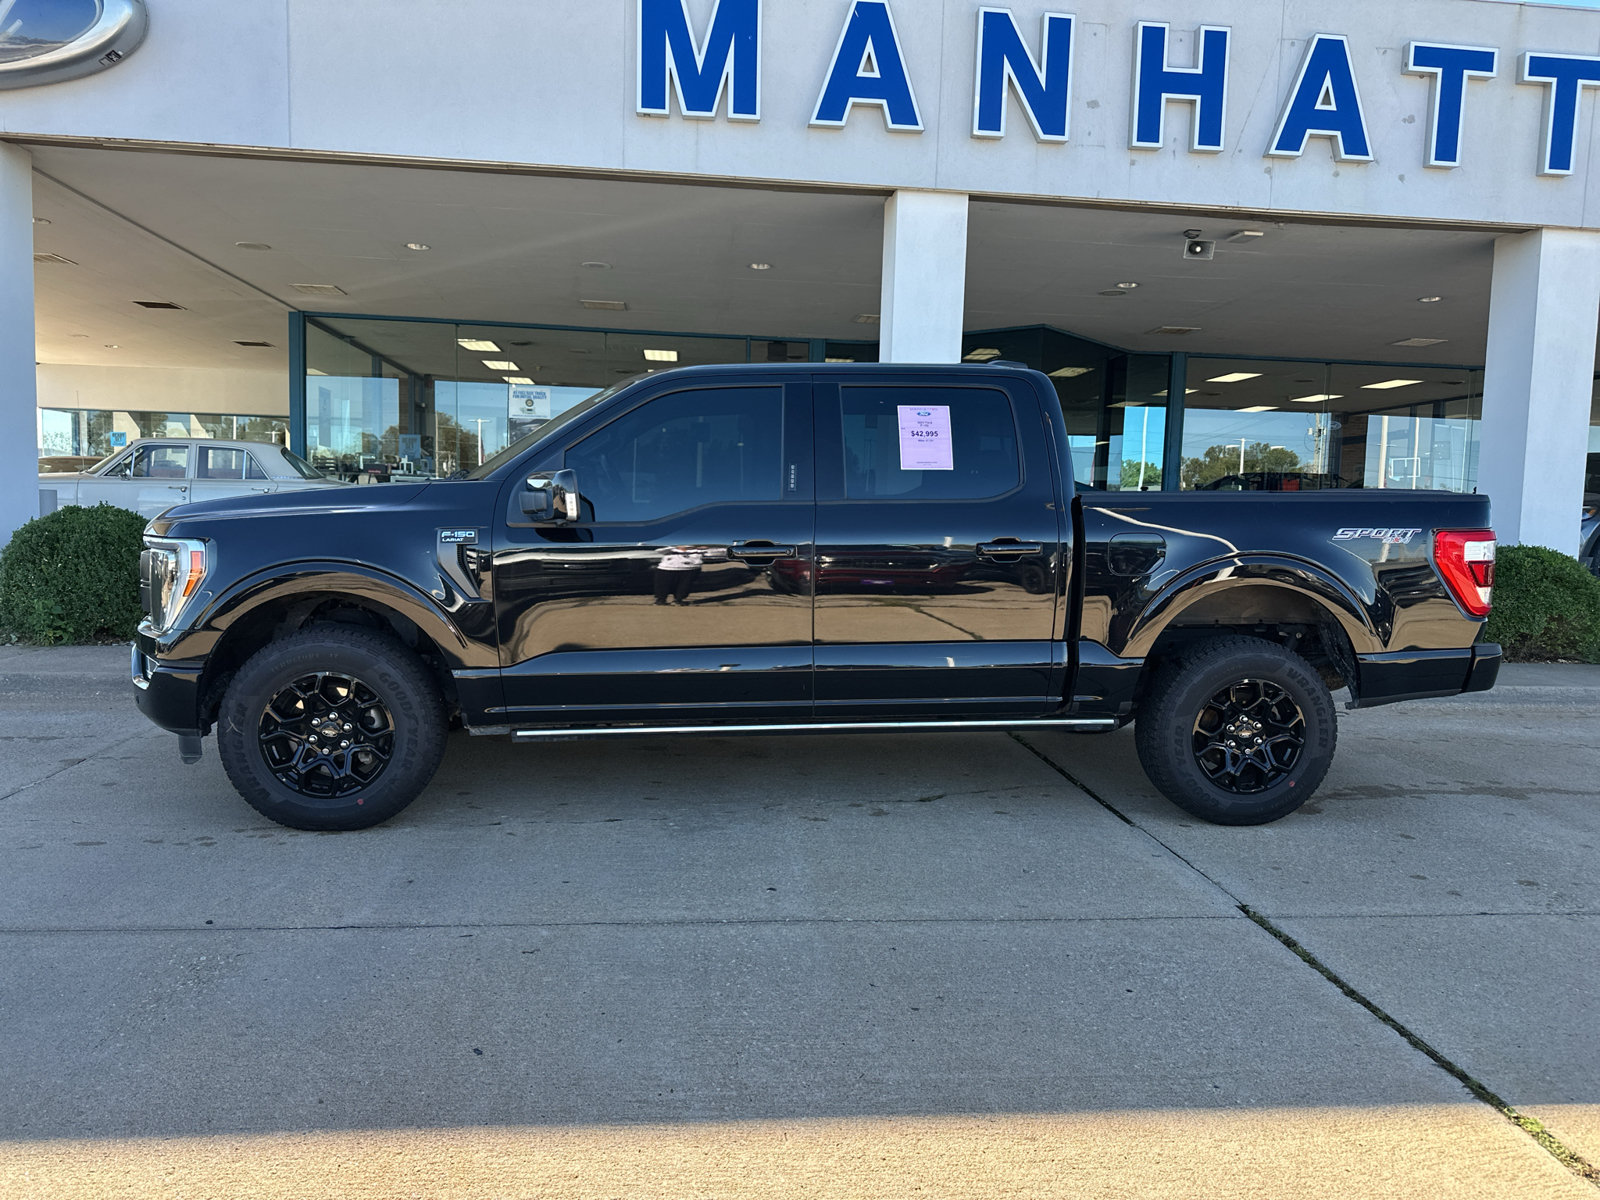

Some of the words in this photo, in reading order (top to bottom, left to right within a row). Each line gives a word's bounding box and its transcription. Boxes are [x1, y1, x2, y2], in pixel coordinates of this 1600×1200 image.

[636, 0, 1600, 177] MANHATT
[911, 430, 939, 438] $42,995
[1332, 528, 1422, 540] SPORT
[234, 702, 272, 800] WRANGLER
[379, 672, 418, 769] GOODYEAR
[1286, 667, 1328, 747] WRANGLER
